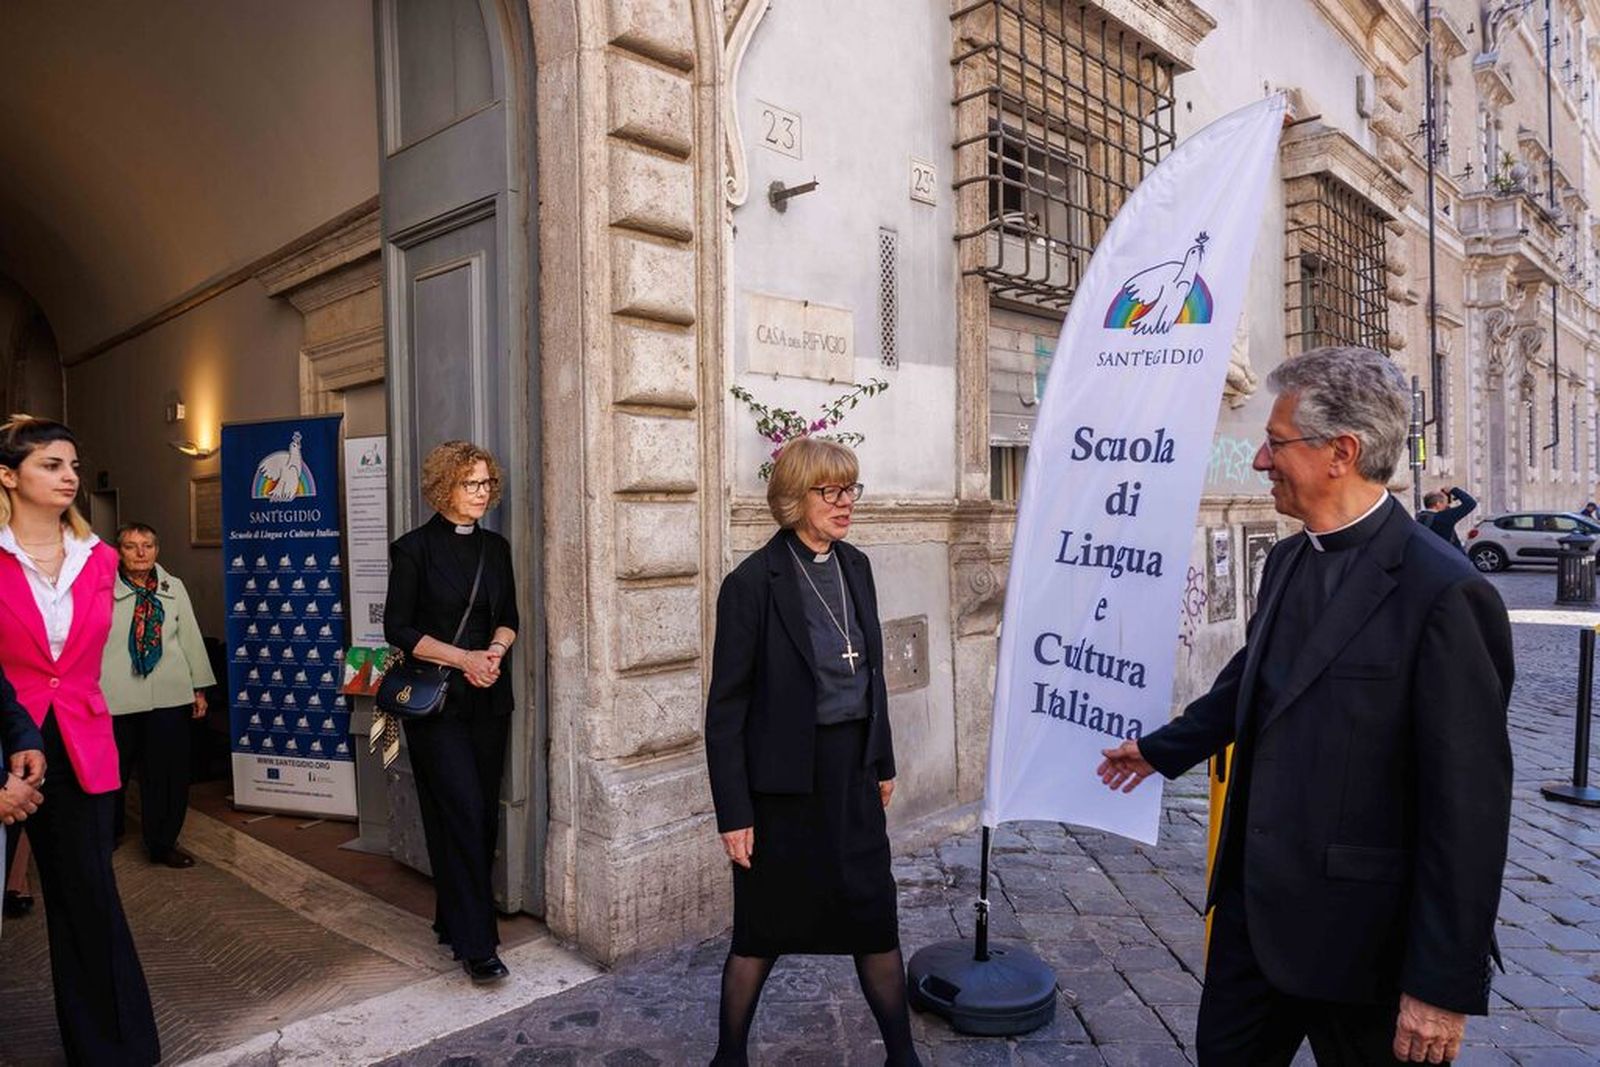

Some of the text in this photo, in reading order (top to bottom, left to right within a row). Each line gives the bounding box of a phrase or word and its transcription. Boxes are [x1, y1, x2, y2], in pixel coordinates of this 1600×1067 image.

[762, 109, 795, 150] 23
[756, 324, 787, 346] CASA
[1096, 348, 1204, 368] SANT'EGIDIO
[1071, 426, 1175, 464] Scuola
[249, 508, 321, 524] SANT'EGIDIO
[1105, 481, 1142, 517] di
[1055, 530, 1163, 579] Lingua
[1094, 596, 1109, 621] e
[1033, 632, 1147, 689] Cultura
[1031, 681, 1143, 740] Italiana
